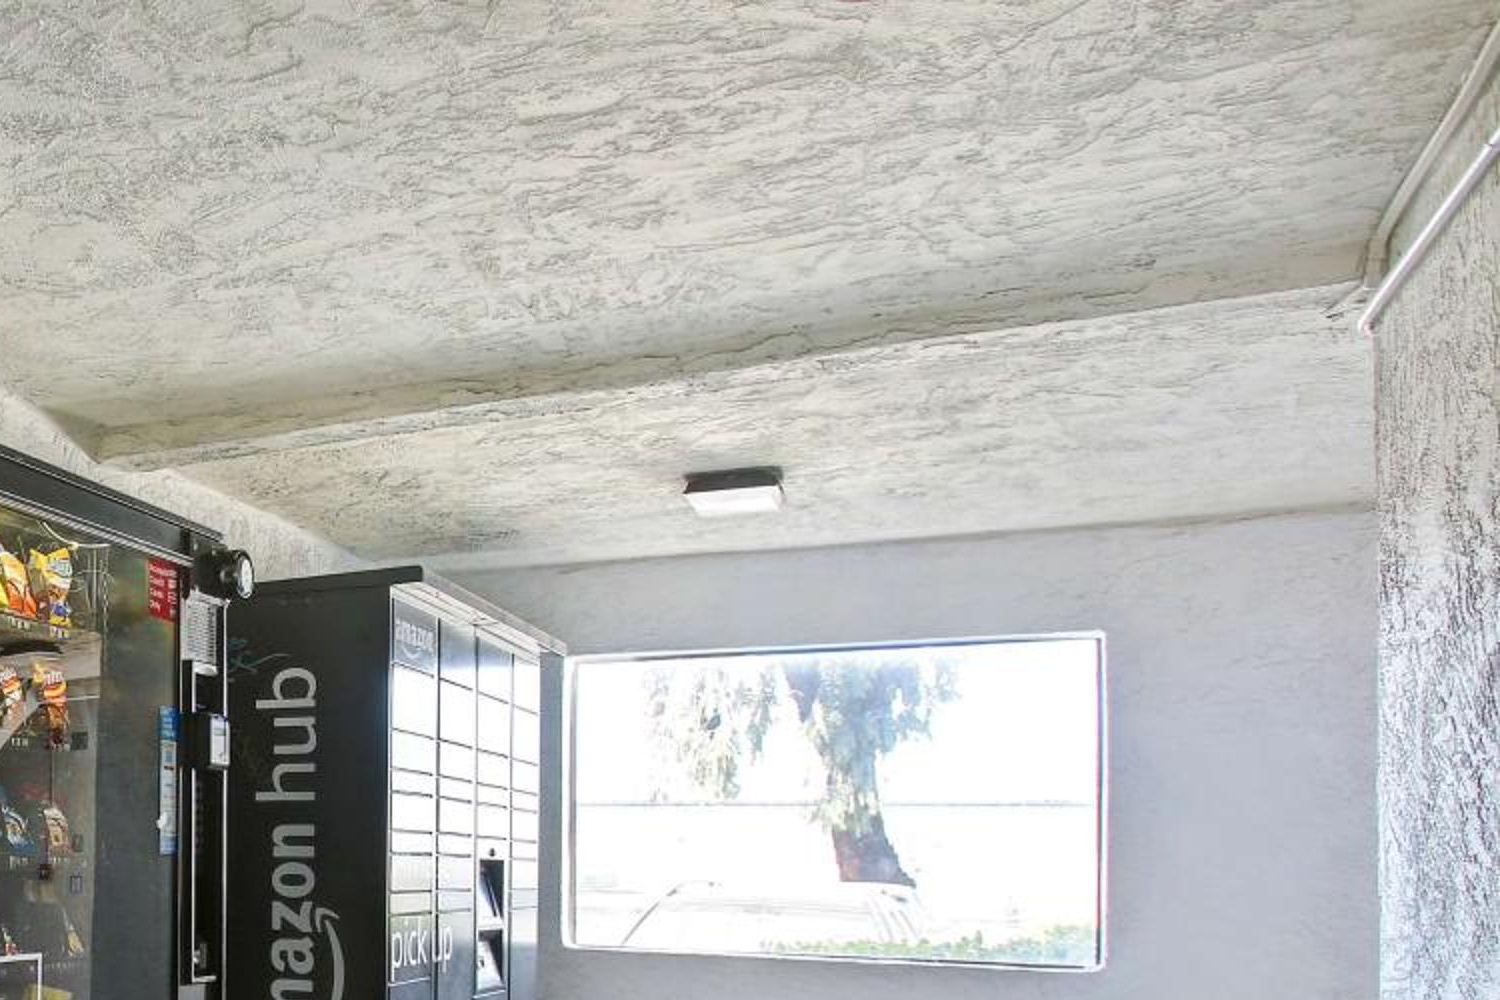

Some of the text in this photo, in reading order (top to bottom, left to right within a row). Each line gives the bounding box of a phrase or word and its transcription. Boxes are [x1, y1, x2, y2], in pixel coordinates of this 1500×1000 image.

[255, 667, 317, 801] hub
[391, 918, 453, 981] pick up
